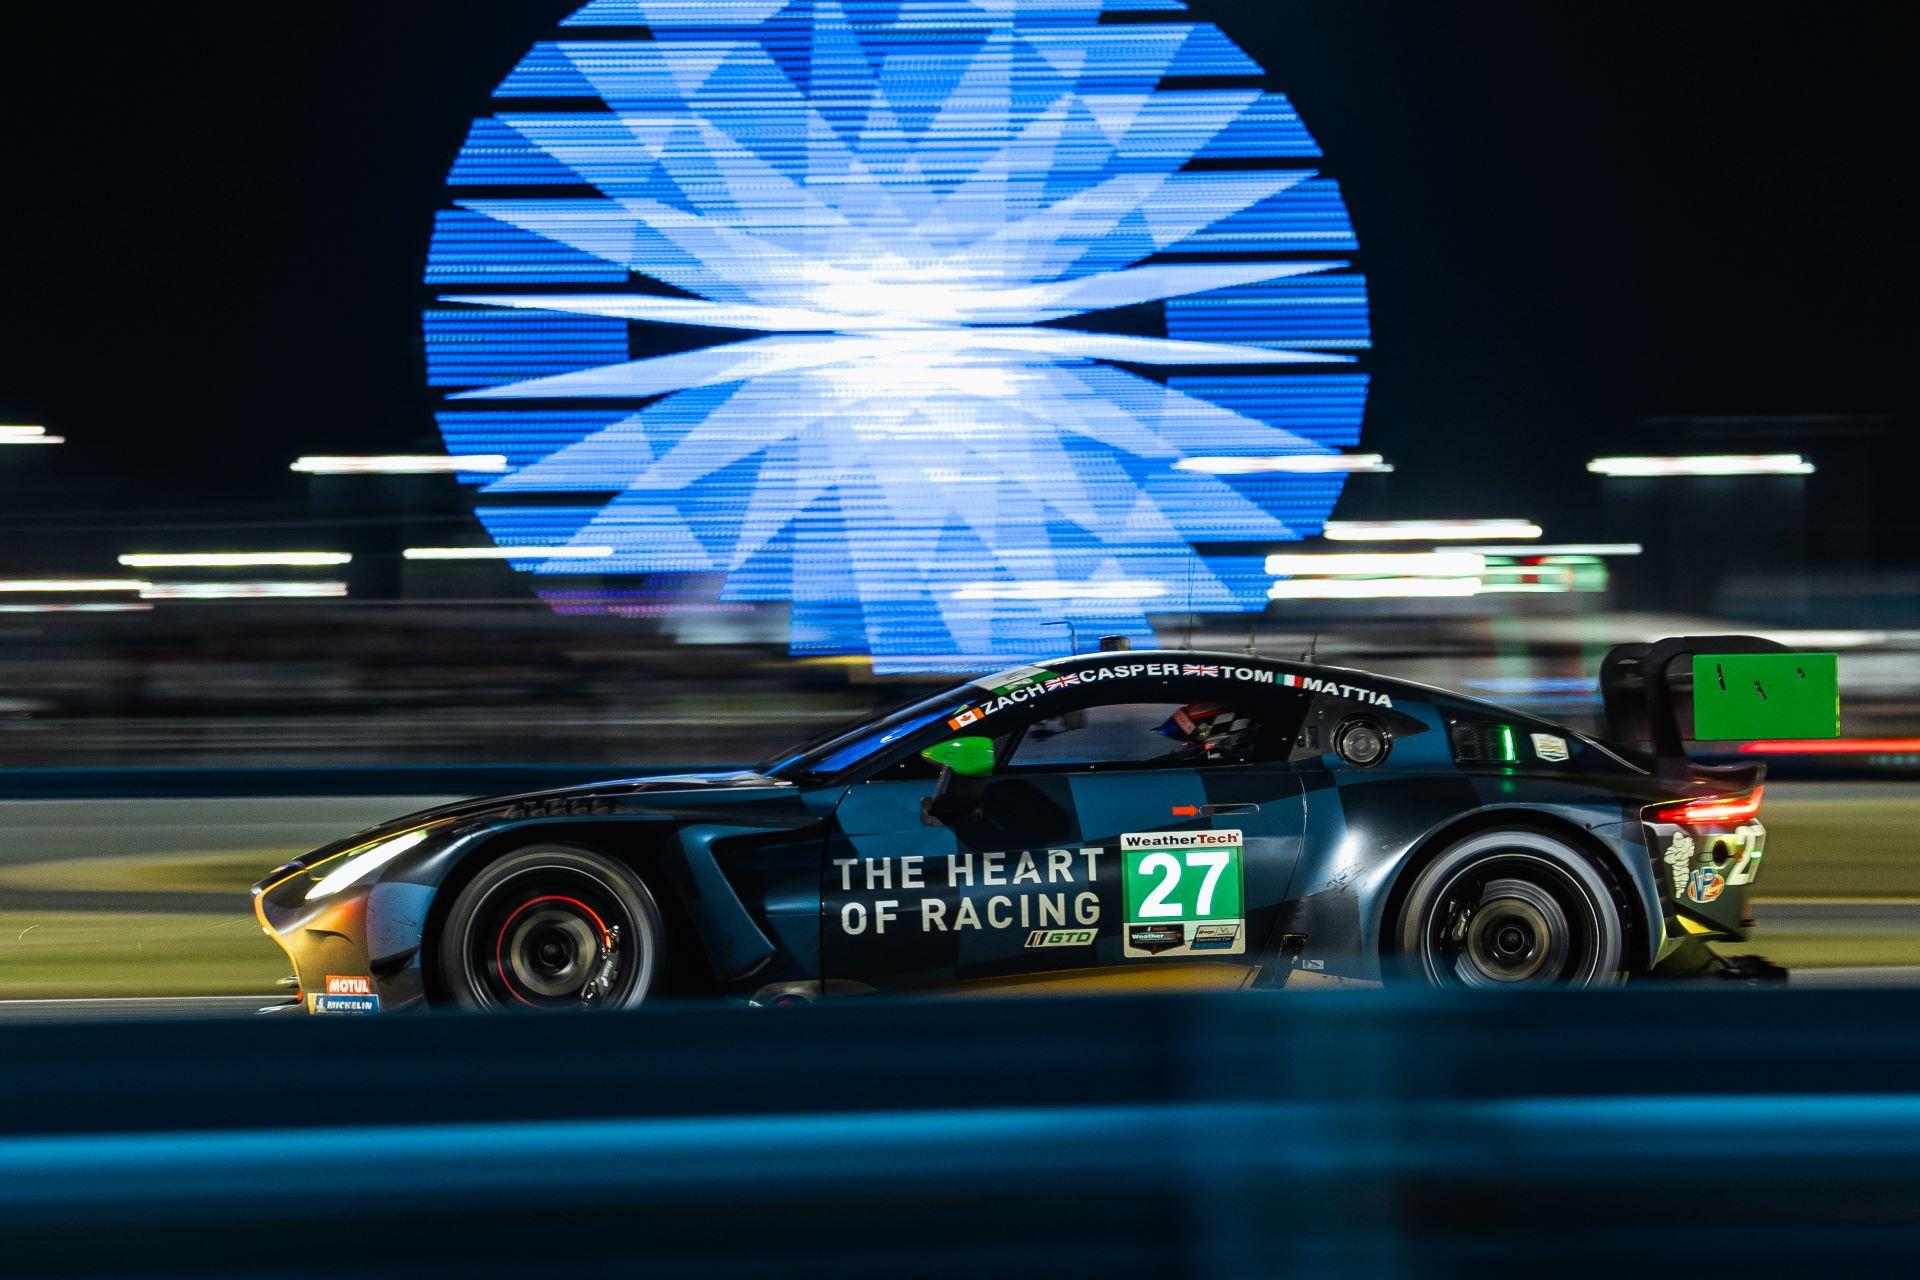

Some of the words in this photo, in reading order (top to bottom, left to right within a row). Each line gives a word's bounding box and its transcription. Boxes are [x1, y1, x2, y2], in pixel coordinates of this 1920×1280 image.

[980, 683, 1046, 715] ZACH
[1079, 663, 1180, 682] CASPER
[1219, 665, 1274, 684] TOM
[1303, 677, 1393, 709] MATTIA
[1126, 833, 1238, 847] WeatherTech
[833, 855, 925, 890] THE
[947, 847, 1105, 888] HEART
[1138, 851, 1230, 918] 27
[841, 900, 899, 935] OF
[921, 891, 1101, 932] RACING
[1048, 931, 1092, 944] GTD
[1131, 932, 1182, 940] Weatherh
[329, 979, 369, 993] MOTUL
[327, 1001, 373, 1010] MICHELIN
